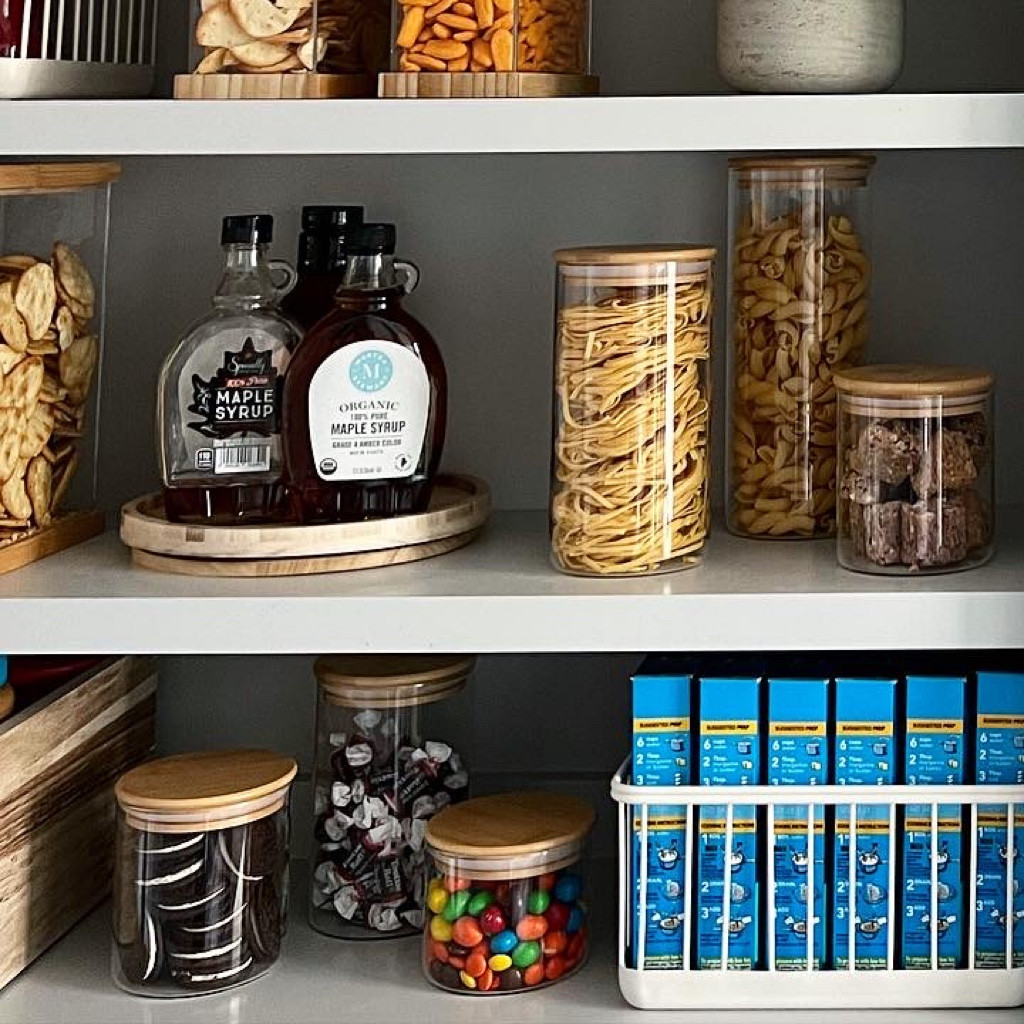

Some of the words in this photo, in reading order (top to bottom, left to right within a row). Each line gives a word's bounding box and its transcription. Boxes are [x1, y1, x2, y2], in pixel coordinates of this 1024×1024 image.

[216, 389, 274, 405] MAPLE
[215, 404, 274, 420] SYRUP
[339, 400, 399, 413] ORGANIC
[331, 421, 368, 436] MAPLE
[370, 420, 406, 435] SYRUP
[636, 736, 645, 748] 6
[909, 737, 918, 748] 6
[980, 732, 988, 743] 6
[703, 739, 711, 750] 6
[772, 739, 780, 751] 6
[839, 739, 847, 751] 6
[636, 754, 644, 765] 2
[909, 754, 917, 765] 2
[979, 749, 986, 761] 2
[703, 756, 711, 767] 2
[771, 757, 779, 768] 2
[838, 757, 846, 768] 2
[907, 832, 914, 843] 1
[906, 879, 914, 891] 2
[976, 874, 984, 886] 2
[701, 881, 709, 893] 2
[837, 881, 845, 893] 2
[906, 905, 914, 917] 3
[976, 900, 984, 911] 3
[701, 907, 709, 919] 3
[837, 907, 845, 919] 3
